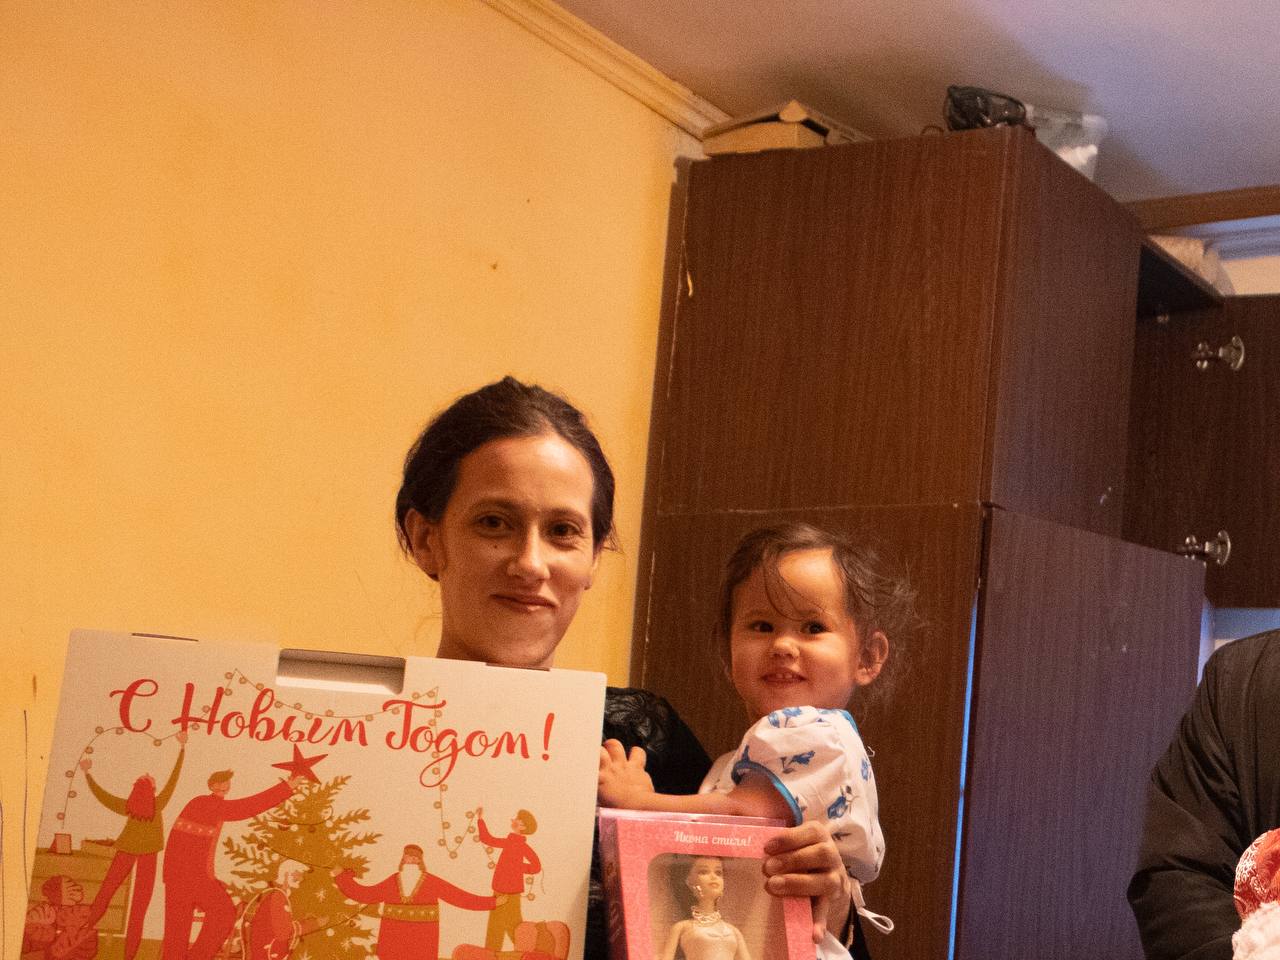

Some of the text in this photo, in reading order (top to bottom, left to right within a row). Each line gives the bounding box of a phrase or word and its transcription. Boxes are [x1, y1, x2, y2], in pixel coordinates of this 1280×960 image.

[109, 678, 556, 788] С Новым Годом!
[674, 831, 751, 846] Икона стиля!
